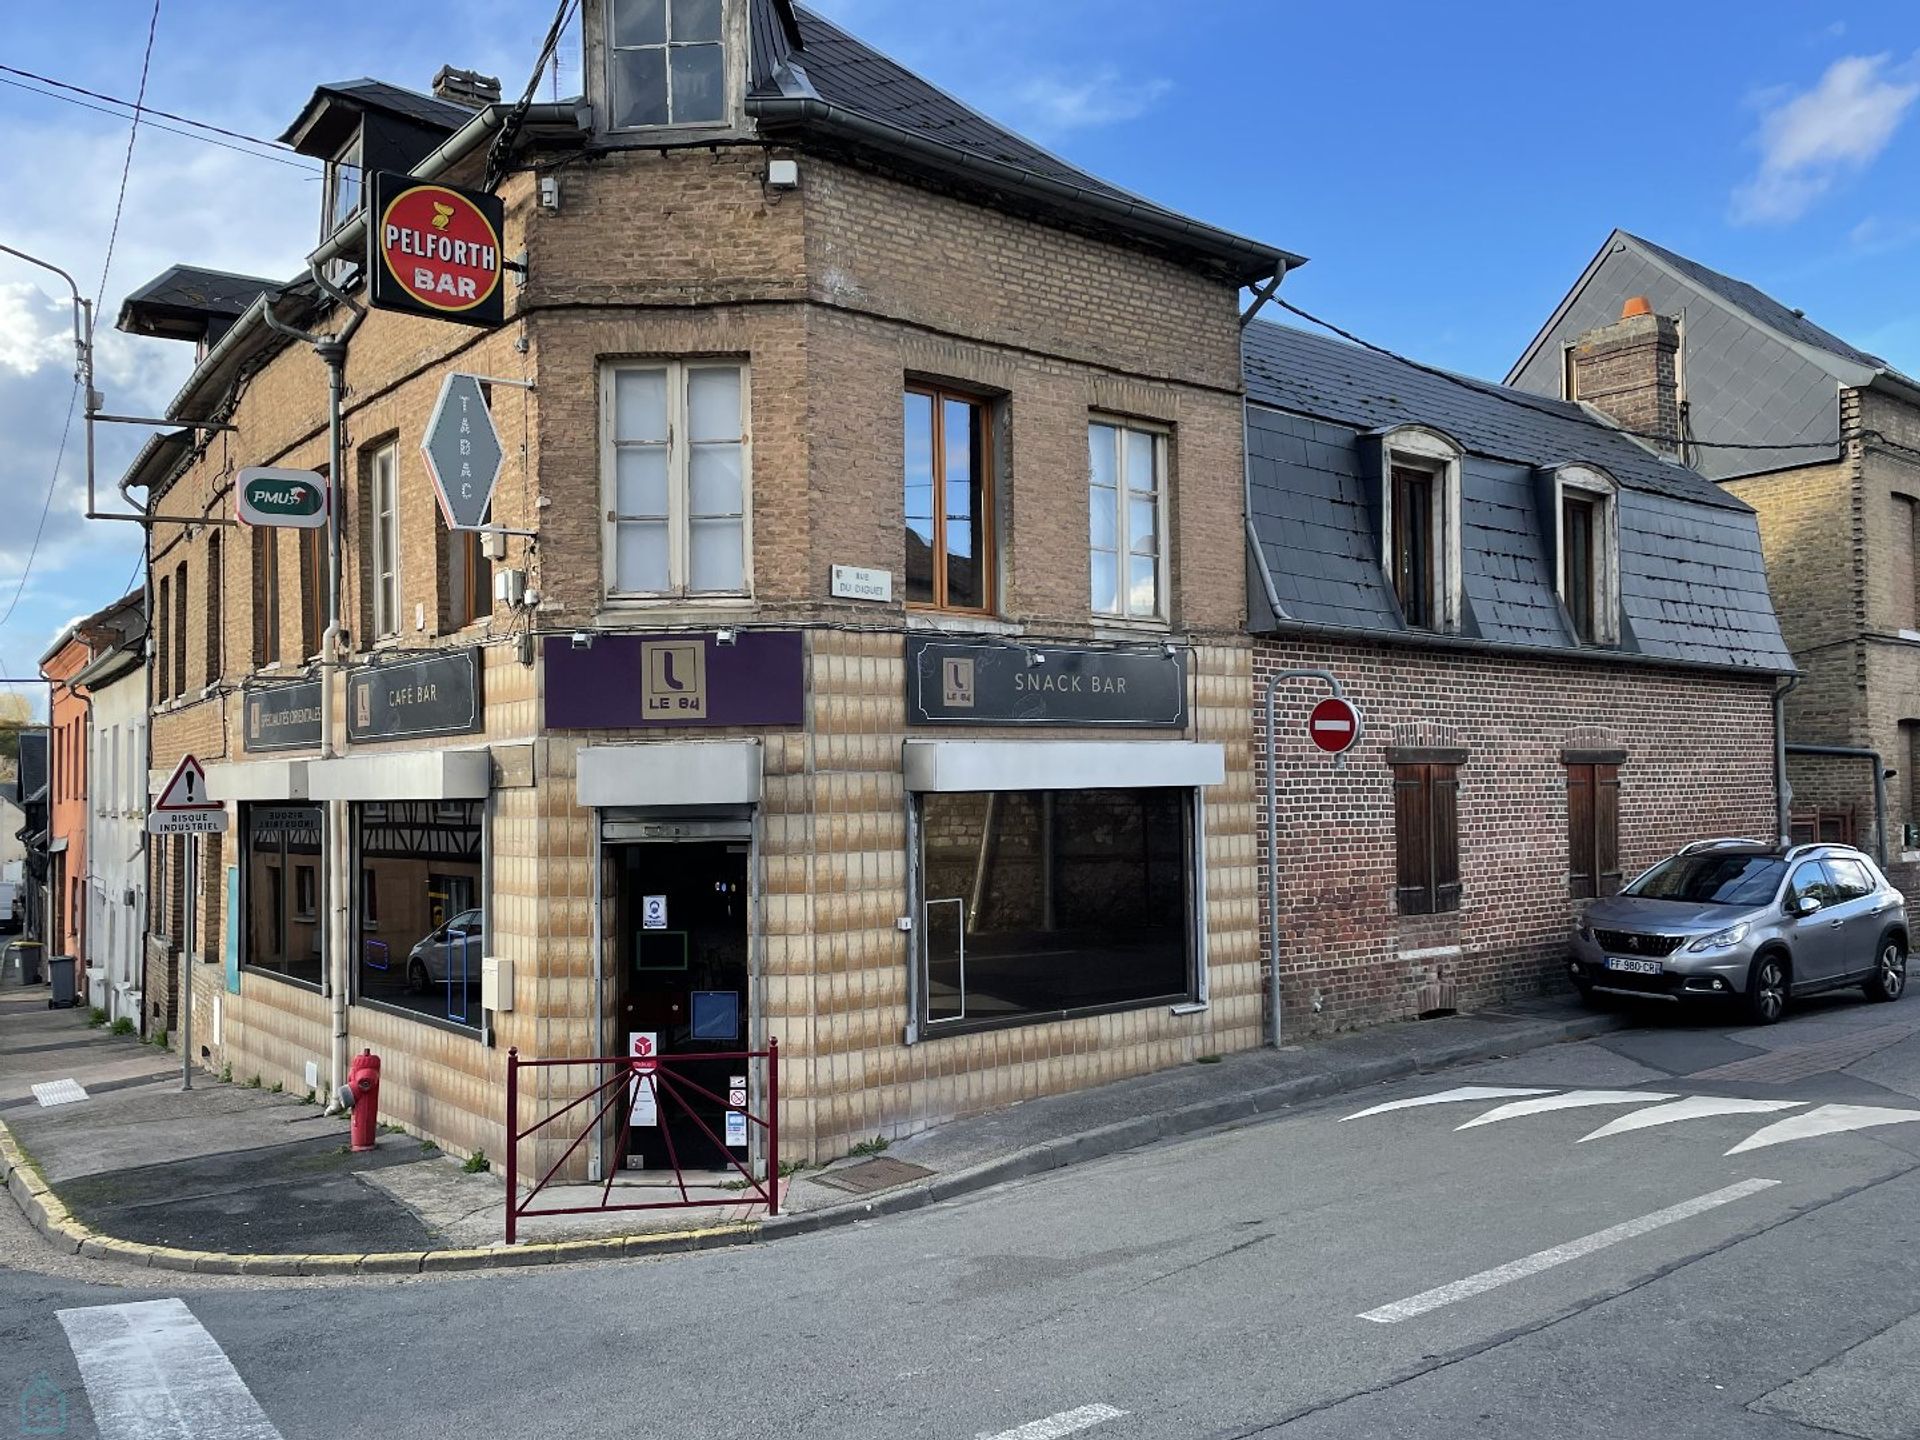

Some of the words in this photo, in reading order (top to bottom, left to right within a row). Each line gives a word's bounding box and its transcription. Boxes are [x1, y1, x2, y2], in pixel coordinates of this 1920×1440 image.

[386, 224, 495, 271] PELFORTH
[414, 267, 476, 300] BAR
[459, 395, 473, 499] TABAC
[253, 491, 290, 504] PMU
[840, 582, 852, 593] DU
[1015, 673, 1082, 693] SNACK
[1091, 676, 1126, 694] BAR
[389, 684, 414, 707] CAFÉ
[417, 684, 438, 703] BAR
[649, 697, 670, 710] LE
[679, 697, 699, 711] 84
[171, 813, 208, 823] RISQUE
[160, 822, 219, 832] INDUSTRIEL
